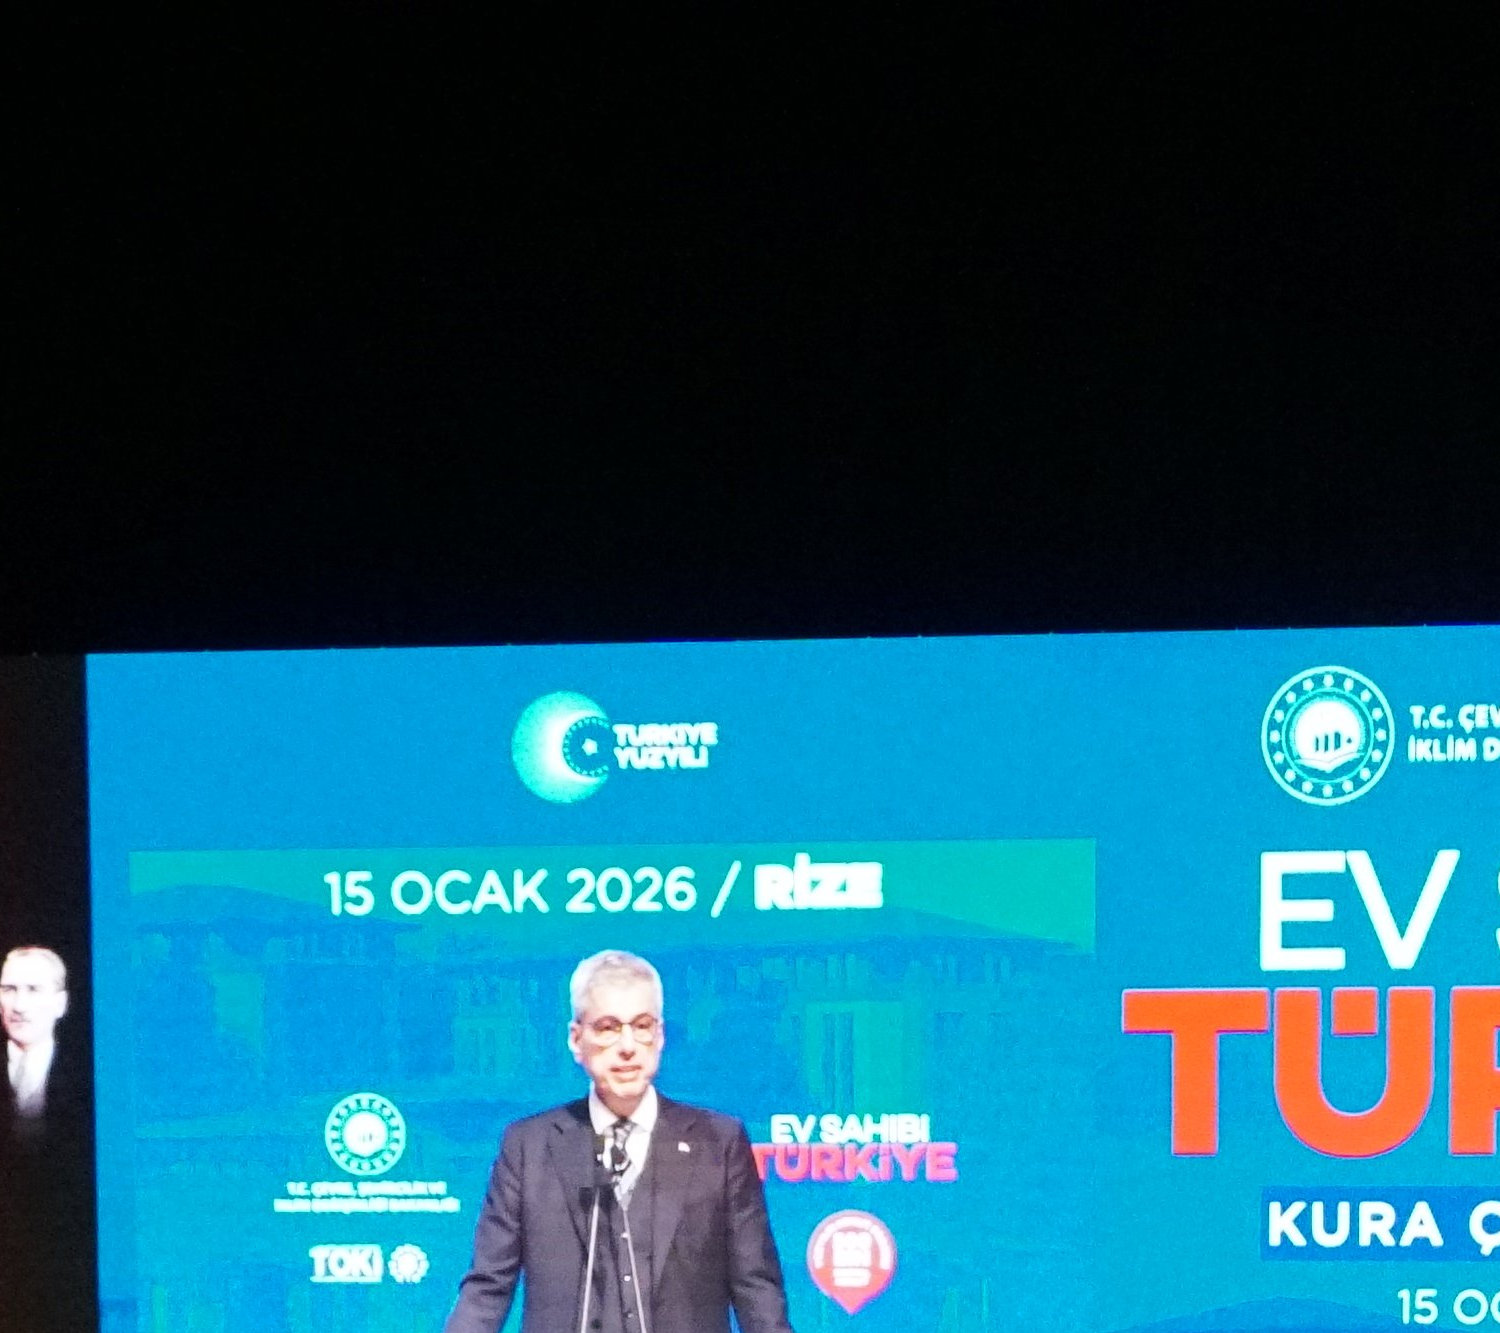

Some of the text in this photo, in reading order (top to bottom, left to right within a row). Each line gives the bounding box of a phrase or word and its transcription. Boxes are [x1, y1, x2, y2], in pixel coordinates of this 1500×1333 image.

[1409, 705, 1453, 729] T.C.
[324, 871, 375, 915] 15
[391, 869, 549, 915] OCAK
[565, 866, 698, 914] 2026
[710, 860, 741, 918] /
[1259, 848, 1461, 970] EV
[770, 1113, 816, 1143] EV
[1267, 1199, 1442, 1248] KURA
[1397, 1288, 1439, 1326] 15
